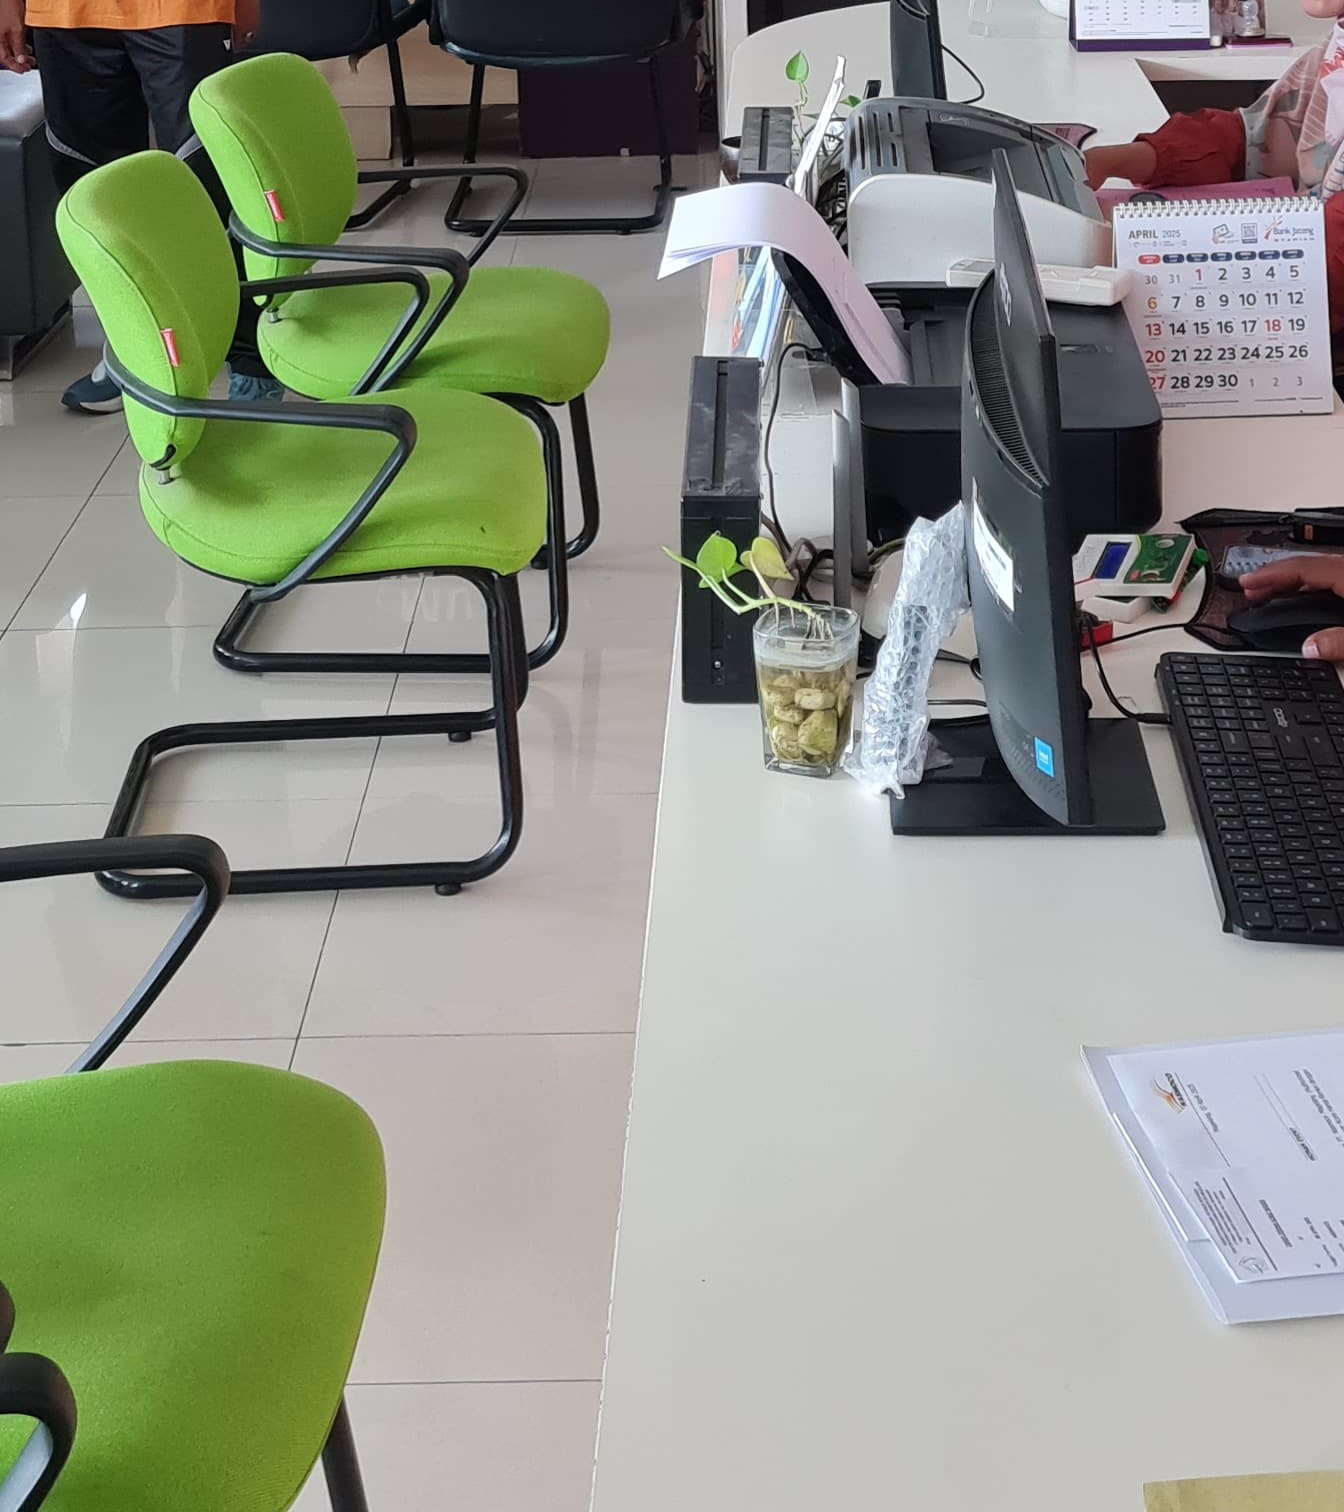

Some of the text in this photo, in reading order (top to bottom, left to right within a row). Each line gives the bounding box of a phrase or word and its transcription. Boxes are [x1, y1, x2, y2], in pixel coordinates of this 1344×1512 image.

[1128, 230, 1158, 240] APRIL
[1144, 265, 1299, 285] 30 31 1 2 3 4 5
[1147, 291, 1304, 310] 6 7 8 9 10 11 12
[1145, 318, 1305, 336] 13 14 15 16 17 18 19
[1145, 345, 1308, 363] 20 21 22 23 24 25 26
[1170, 376, 1190, 389] 28
[1194, 375, 1214, 388] 29
[1217, 374, 1238, 387] 30
[1272, 377, 1279, 387] 2
[1296, 376, 1303, 386] 3
